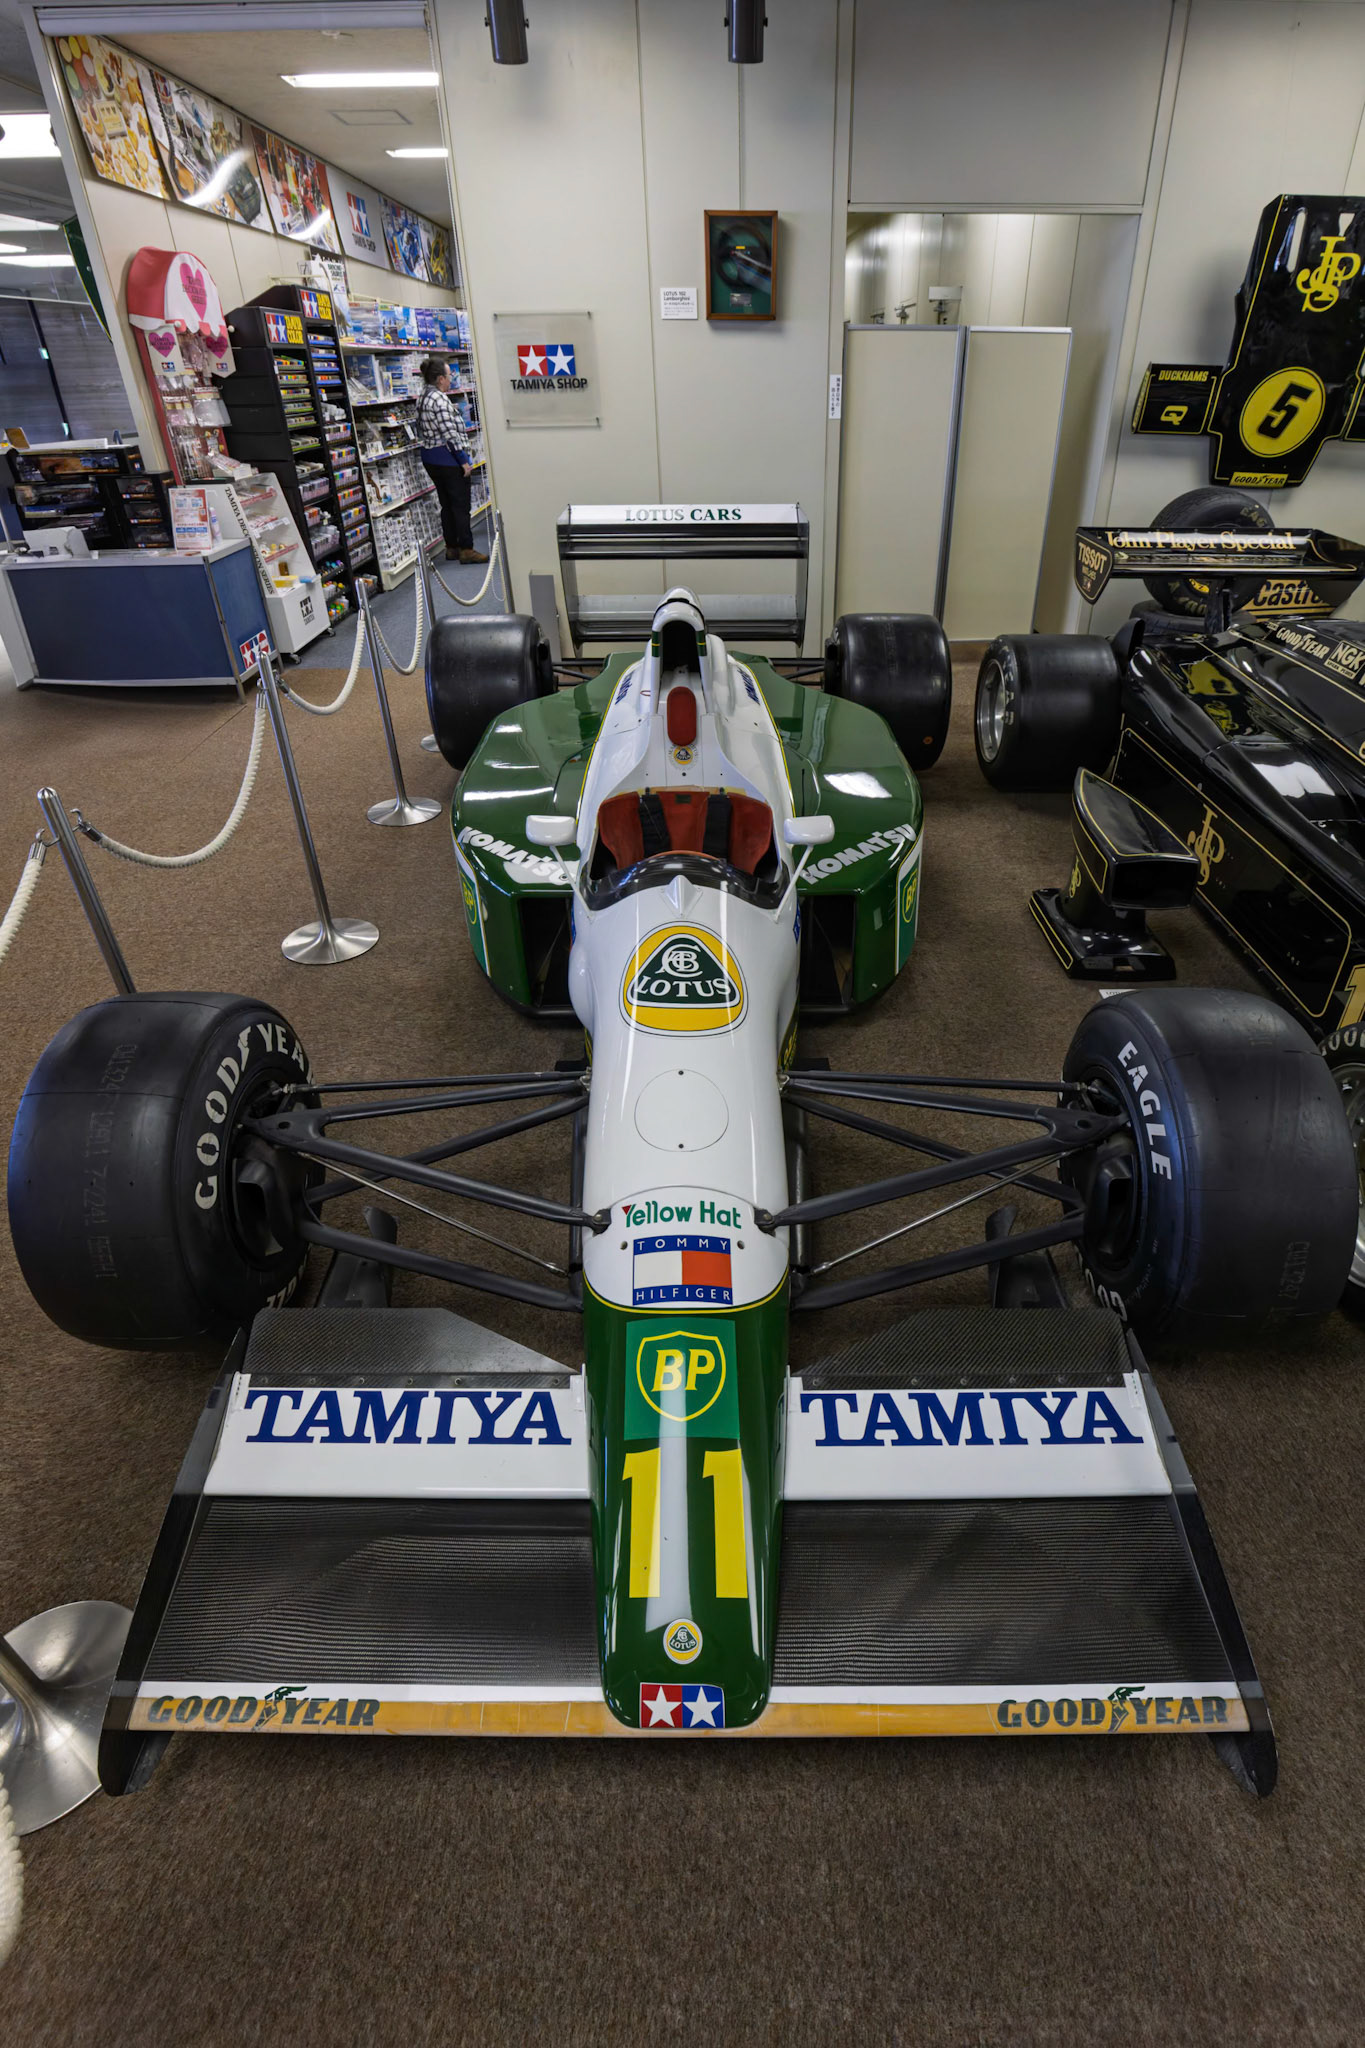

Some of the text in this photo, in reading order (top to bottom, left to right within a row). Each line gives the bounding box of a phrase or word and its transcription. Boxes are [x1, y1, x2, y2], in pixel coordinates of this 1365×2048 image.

[511, 378, 588, 390] TAMIYA SHOP
[1158, 370, 1209, 382] DUCKHAMS
[1256, 382, 1315, 440] 5
[625, 508, 742, 521] LOTUS CARS
[1105, 530, 1296, 552] John Player Special
[1078, 542, 1108, 574] TISSOT
[1331, 642, 1365, 671] NGK
[800, 823, 917, 885] KOMATSU
[635, 975, 731, 998] LOTUS
[1118, 1041, 1172, 1181] EAGLE
[621, 1200, 742, 1229] Yellow Hat
[637, 1238, 728, 1251] TOMMY
[636, 1287, 731, 1301] HILFIGER
[651, 1348, 716, 1392] BP
[244, 1389, 572, 1445] TAMIYA
[800, 1390, 1144, 1446] TAMIYA
[622, 1447, 749, 1599] 11
[671, 1639, 696, 1650] LOTUS
